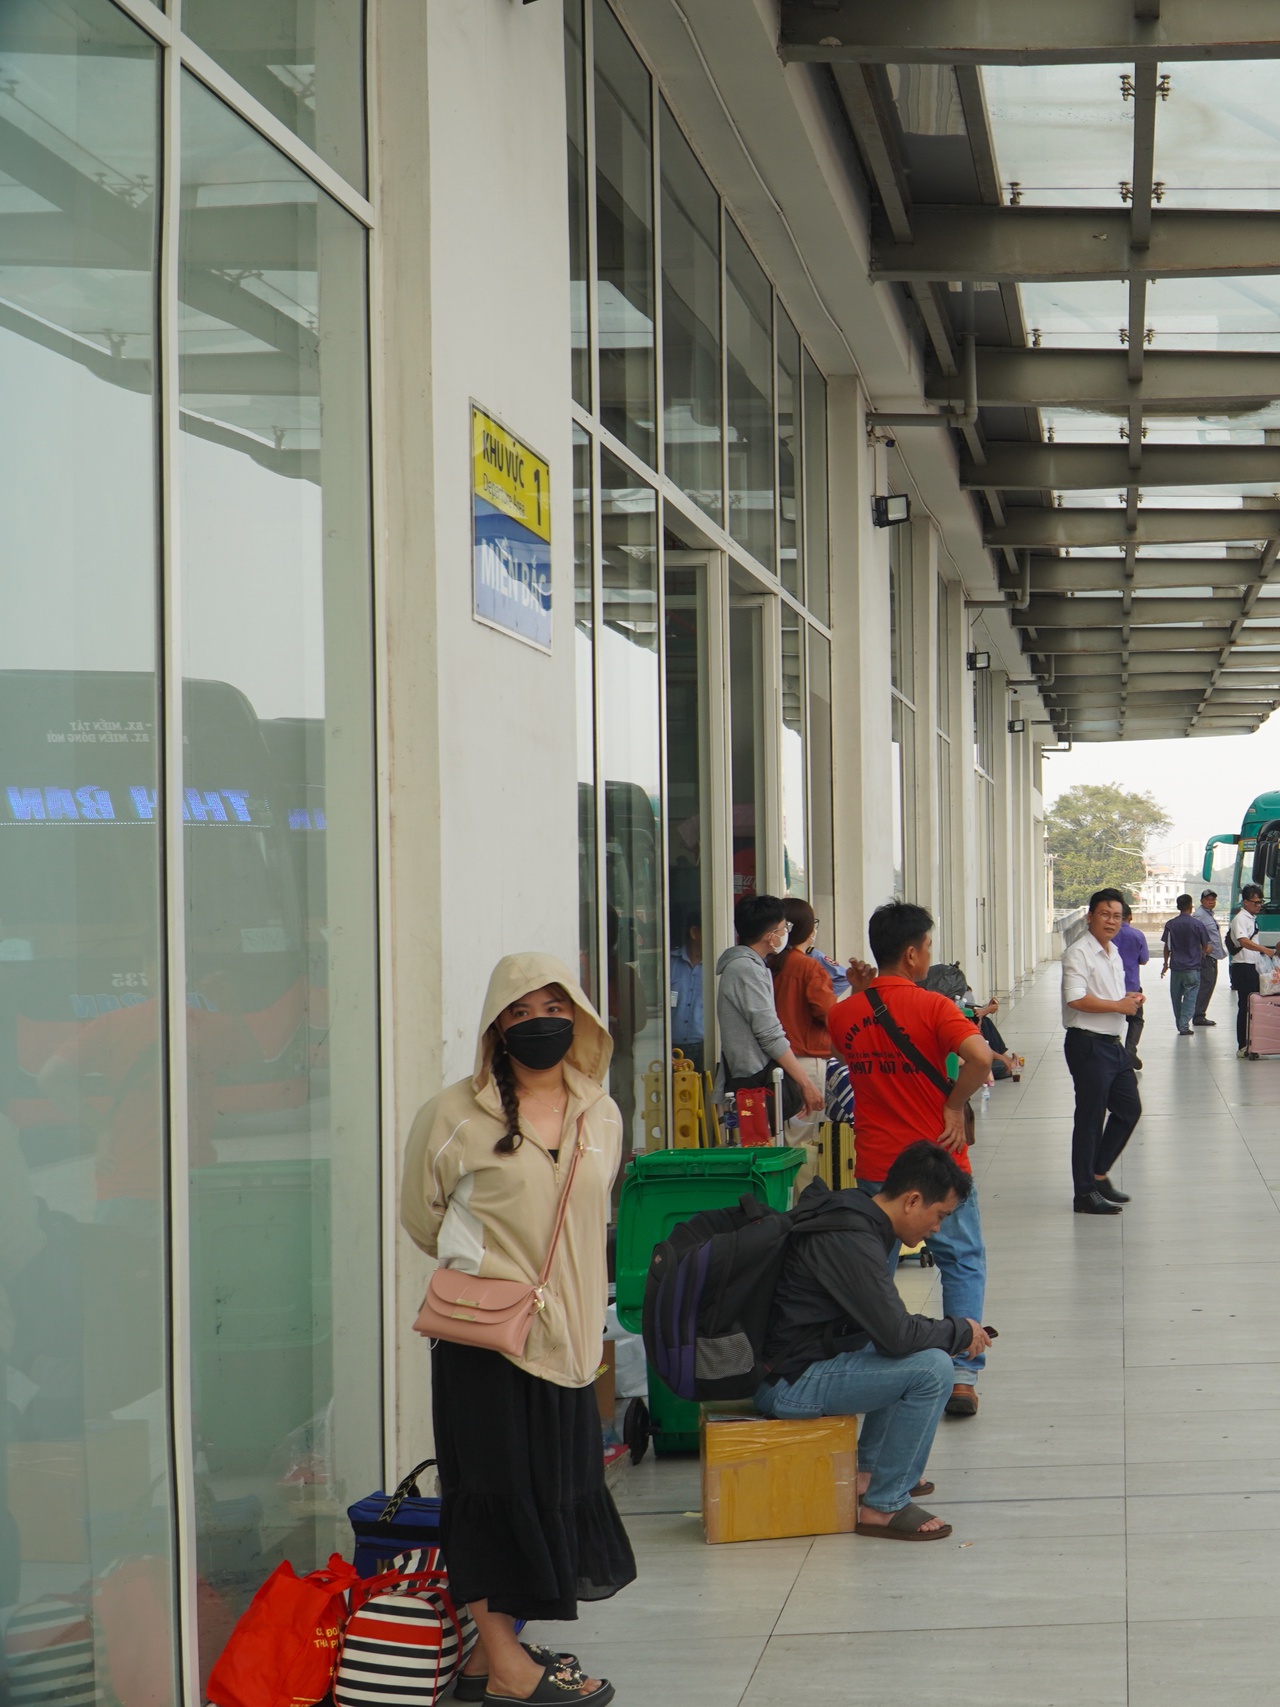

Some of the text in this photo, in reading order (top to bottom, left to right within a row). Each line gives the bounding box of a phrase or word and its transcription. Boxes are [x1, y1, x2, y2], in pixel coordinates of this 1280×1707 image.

[482, 429, 525, 491] KHU VỰC
[482, 472, 513, 512] Departure
[533, 468, 542, 527] 1
